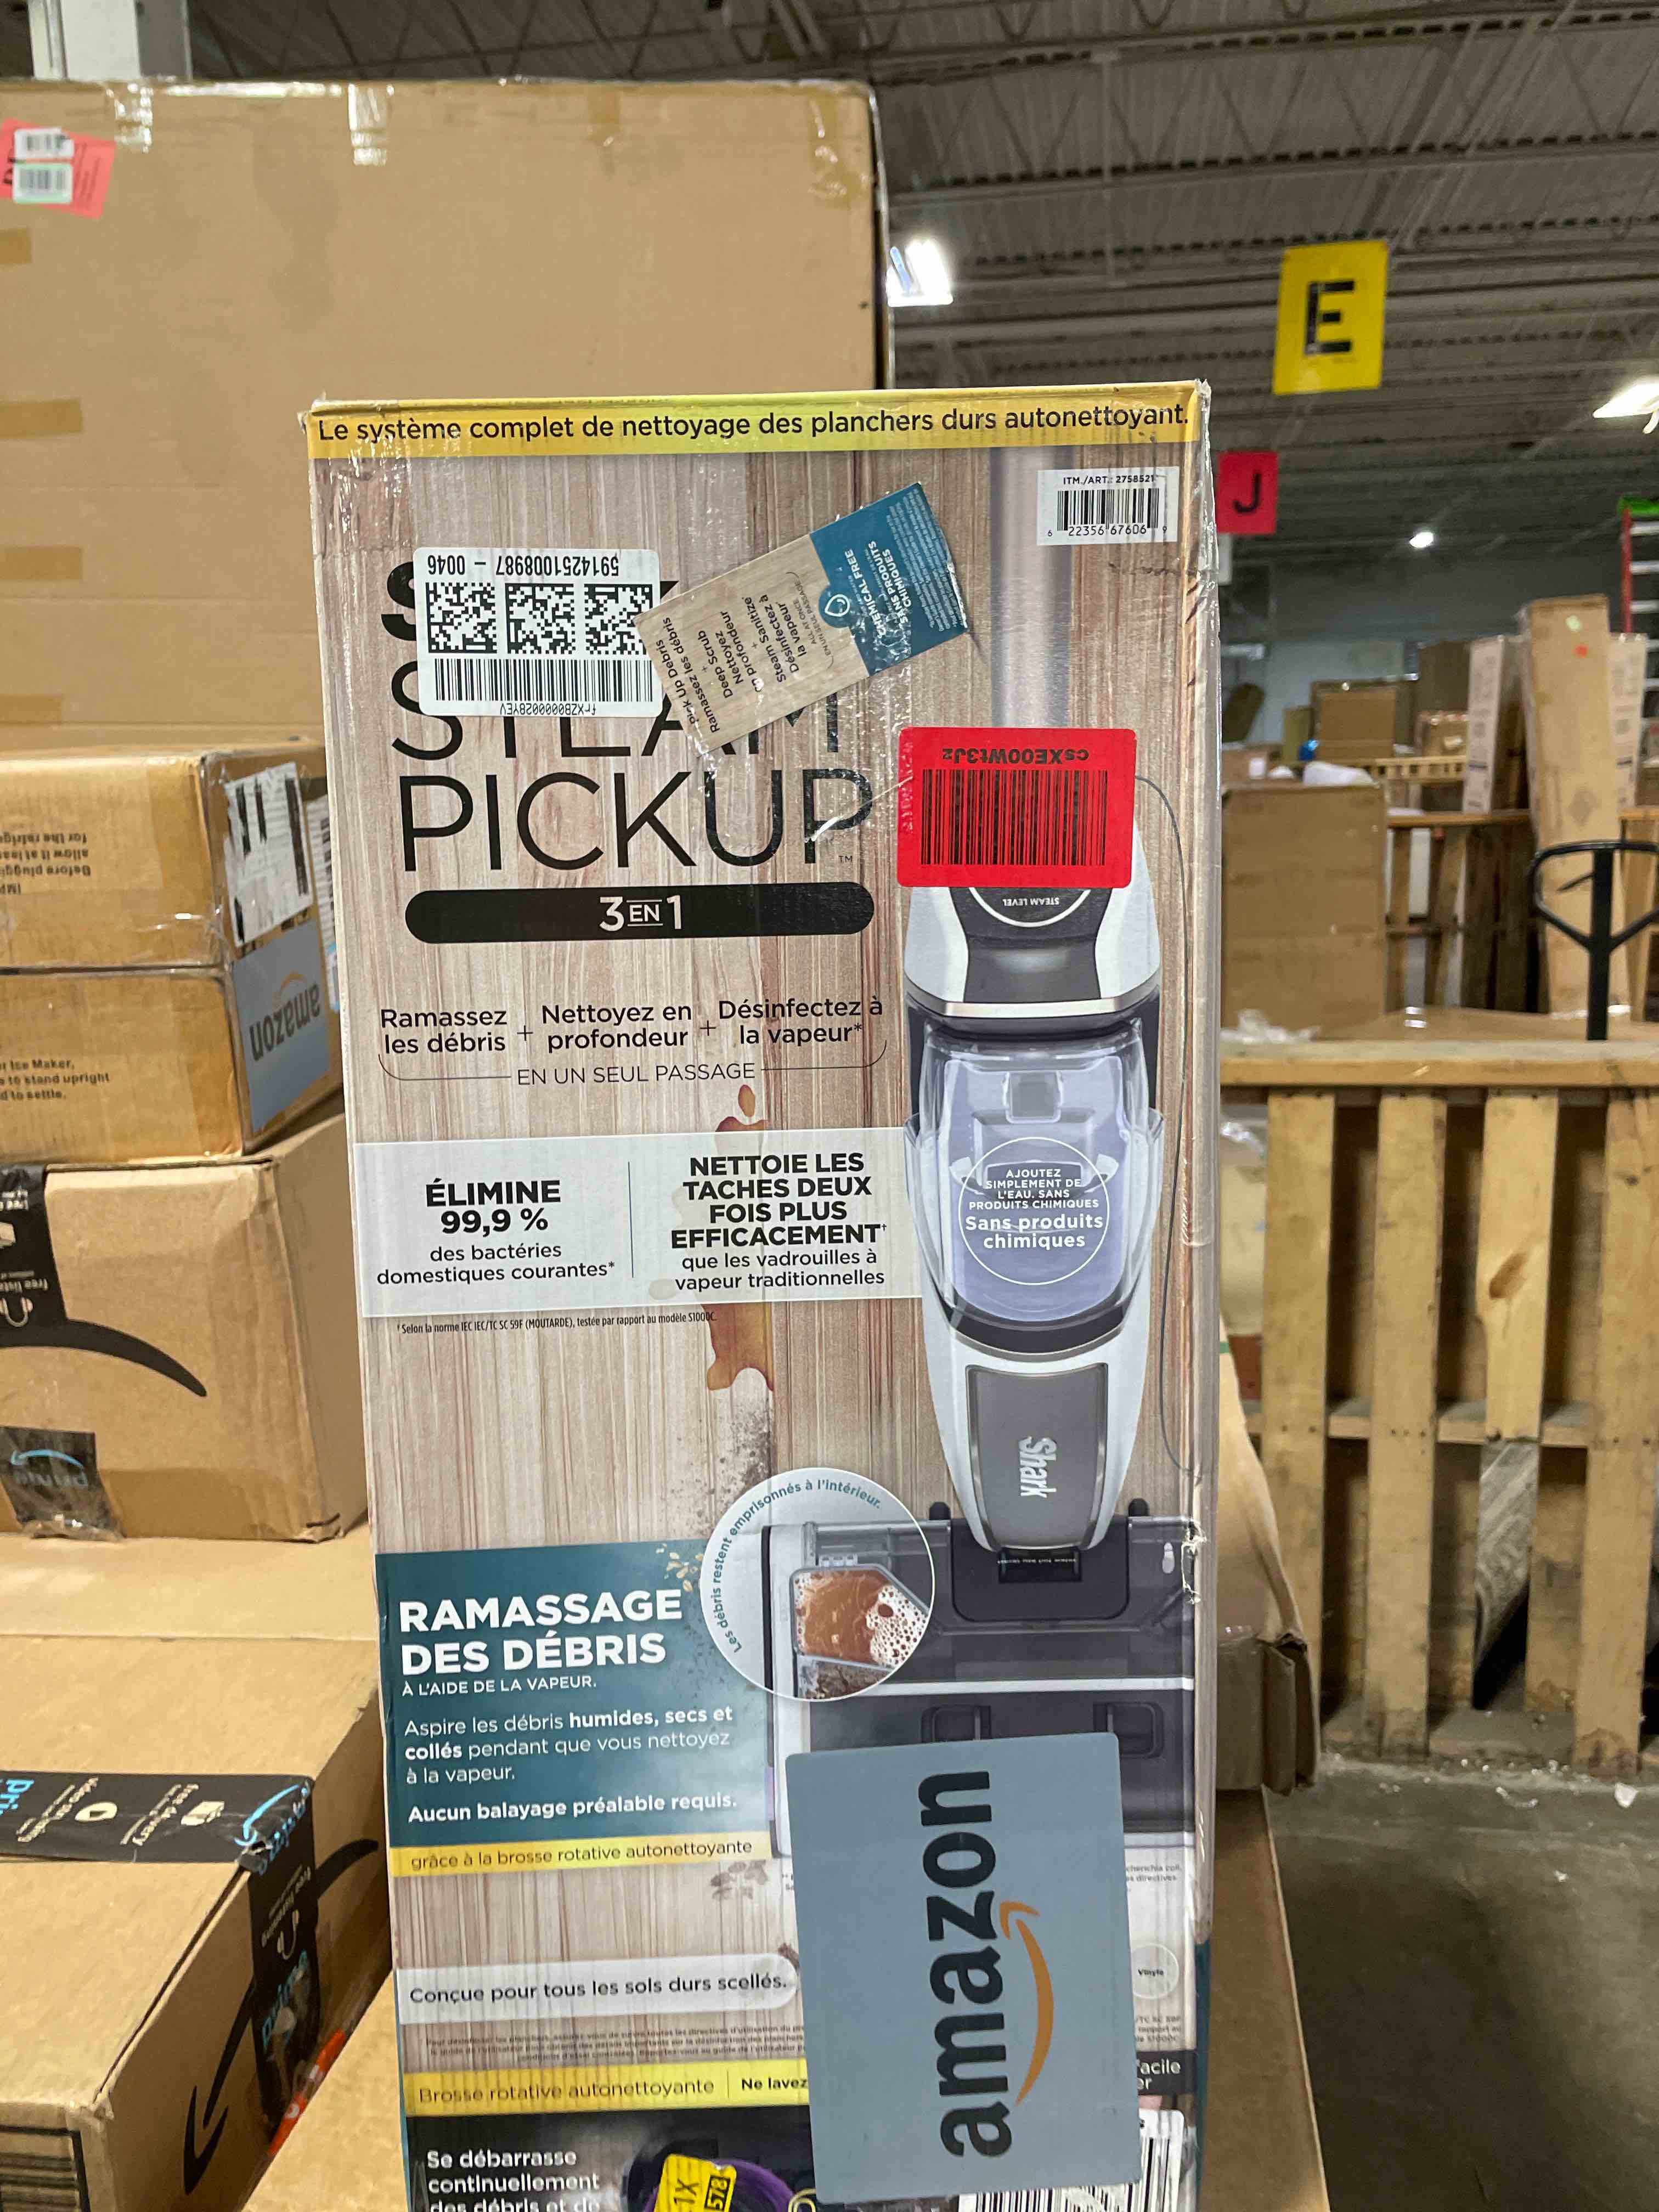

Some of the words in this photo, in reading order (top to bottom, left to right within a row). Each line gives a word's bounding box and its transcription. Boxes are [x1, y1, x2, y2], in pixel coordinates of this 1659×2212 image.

[1304, 280, 1355, 356] E
[319, 420, 348, 439] Le
[357, 417, 461, 443] système
[470, 416, 573, 441] complet
[582, 416, 613, 437] de
[623, 414, 750, 439] nettoyage
[759, 412, 802, 434] des
[812, 410, 933, 436] planchers
[941, 409, 996, 430] durs
[1005, 404, 1188, 429] autonettoyant.
[1116, 475, 1154, 484] 2758521
[1233, 473, 1262, 514] J
[1068, 526, 1104, 536] 22356
[1110, 524, 1147, 535] 67606
[427, 555, 465, 574] 0046
[496, 555, 619, 576] 5914251008987
[843, 548, 864, 579] FREE
[865, 540, 898, 595] PRODUITS
[879, 548, 915, 608] CHIMIQUES
[855, 578, 889, 636] CHEMICAL
[889, 594, 909, 624] SANS
[660, 616, 685, 655] débris
[695, 629, 719, 665] Scrub
[718, 608, 757, 676] profondeur
[761, 603, 801, 674] Désinfectez
[653, 639, 679, 678] Debris
[678, 656, 693, 674] les
[713, 629, 747, 685] Nettoyez
[763, 644, 788, 683] Steam
[672, 678, 688, 698] Up
[712, 665, 734, 698] Deep
[687, 674, 721, 733] Ramassez
[399, 769, 873, 872] PICKUP
[1030, 898, 1059, 906] STEAM
[250, 983, 321, 1062] amazon
[381, 1009, 507, 1028] Ramassez
[542, 1004, 654, 1027] Nettoyez
[663, 1005, 692, 1021] en
[719, 1000, 860, 1020] Désinfectez
[385, 1036, 420, 1054] les
[427, 1032, 505, 1053] débris
[548, 1029, 688, 1052] profondeur
[740, 1026, 760, 1045] la
[25, 1074, 60, 1085] stand
[63, 1073, 110, 1086] upright
[517, 1069, 547, 1085] EN
[555, 1068, 585, 1084] UN
[594, 1066, 648, 1082] SEUL
[656, 1063, 755, 1082] PASSAGE
[690, 1154, 808, 1176] NETTOIE
[815, 1153, 864, 1172] LES
[1006, 1169, 1061, 1178] AJOUTEZ
[426, 1178, 561, 1207] ÉLIMINE
[683, 1178, 790, 1200] TACHES
[798, 1176, 872, 1197] DEUX
[986, 1179, 1062, 1189] SIMPLEMENT
[1066, 1179, 1081, 1187] DE
[998, 1190, 1035, 1199] L'EAU.
[1039, 1189, 1070, 1198] SANS
[710, 1203, 771, 1223] FOIS
[780, 1201, 847, 1221] PLUS
[969, 1200, 1029, 1210] PRODUITS
[1032, 1199, 1099, 1209] CHIMIQUES
[441, 1209, 511, 1238] 99,9
[521, 1207, 548, 1231] %
[966, 1216, 1011, 1231] Sans
[1018, 1213, 1103, 1234] produits
[430, 1246, 465, 1261] des
[471, 1243, 561, 1260] bactéries
[984, 1233, 1085, 1250] chimiques
[377, 1267, 505, 1284] domestiques
[682, 1255, 718, 1272] que
[725, 1253, 750, 1268] les
[757, 1250, 860, 1267] vadrouilles
[675, 1276, 742, 1293] vapeur
[748, 1269, 884, 1288] traditionnelles
[402, 1324, 423, 1334] Selon
[434, 1324, 459, 1333] norme
[461, 1322, 472, 1332] IEC
[474, 1321, 498, 1331] IEC/TC
[510, 1319, 523, 1329] 59F
[526, 1318, 575, 1329] (MOUTARDE),
[577, 1317, 600, 1327] testée
[616, 1315, 645, 1327] rapport
[658, 1313, 686, 1323] modèle
[1018, 1436, 1057, 1498] Shark
[729, 1482, 802, 1536] emprisonnés
[817, 1479, 881, 1509] l'intérieur.
[713, 1537, 732, 1581] restent
[399, 1589, 682, 1632] RAMASSAGE
[710, 1587, 729, 1628] débris
[402, 1641, 490, 1675] DES
[503, 1630, 666, 1671] DÉBRIS
[724, 1630, 742, 1654] Les
[402, 1682, 414, 1697] À
[419, 1681, 468, 1696] L'AIDE
[473, 1679, 495, 1693] DE
[501, 1678, 522, 1691] LA
[527, 1676, 596, 1691] VAPEUR.
[405, 1720, 466, 1739] Aspire
[472, 1716, 498, 1734] les
[504, 1712, 564, 1733] débris
[569, 1709, 659, 1729] humides,
[665, 1708, 707, 1725] secs
[713, 1707, 733, 1722] et
[405, 1743, 462, 1760] collés
[469, 1737, 549, 1760] pendant
[555, 1738, 591, 1756] que
[597, 1736, 641, 1751] vous
[648, 1731, 730, 1750] nettoyez
[408, 1804, 471, 1824] Aucun
[477, 1800, 567, 1822] balayage
[573, 1795, 665, 1818] préalable
[670, 1792, 737, 1813] requis.
[411, 1853, 458, 1872] grâce
[478, 1849, 492, 1865] la
[498, 1847, 552, 1865] brosse
[558, 1844, 620, 1862] rotative
[626, 1839, 752, 1860] autonettoyante
[918, 1770, 1012, 2158] amazon
[410, 1986, 484, 2005] Conçue
[491, 1984, 537, 2002] pour
[544, 1981, 585, 1997] tous
[592, 1979, 619, 1996] les
[625, 1976, 662, 1994] sols
[669, 1975, 712, 1993] durs
[718, 1972, 787, 1991] scellés.
[419, 2087, 484, 2104] Brosse
[489, 2084, 562, 2102] rotative
[568, 2079, 714, 2100] autonettoyante
[741, 2077, 764, 2091] Ne
[769, 2074, 808, 2091] lavez
[427, 2150, 453, 2168] Se
[460, 2148, 577, 2168] débarrasse
[428, 2172, 600, 2193] continuellement
